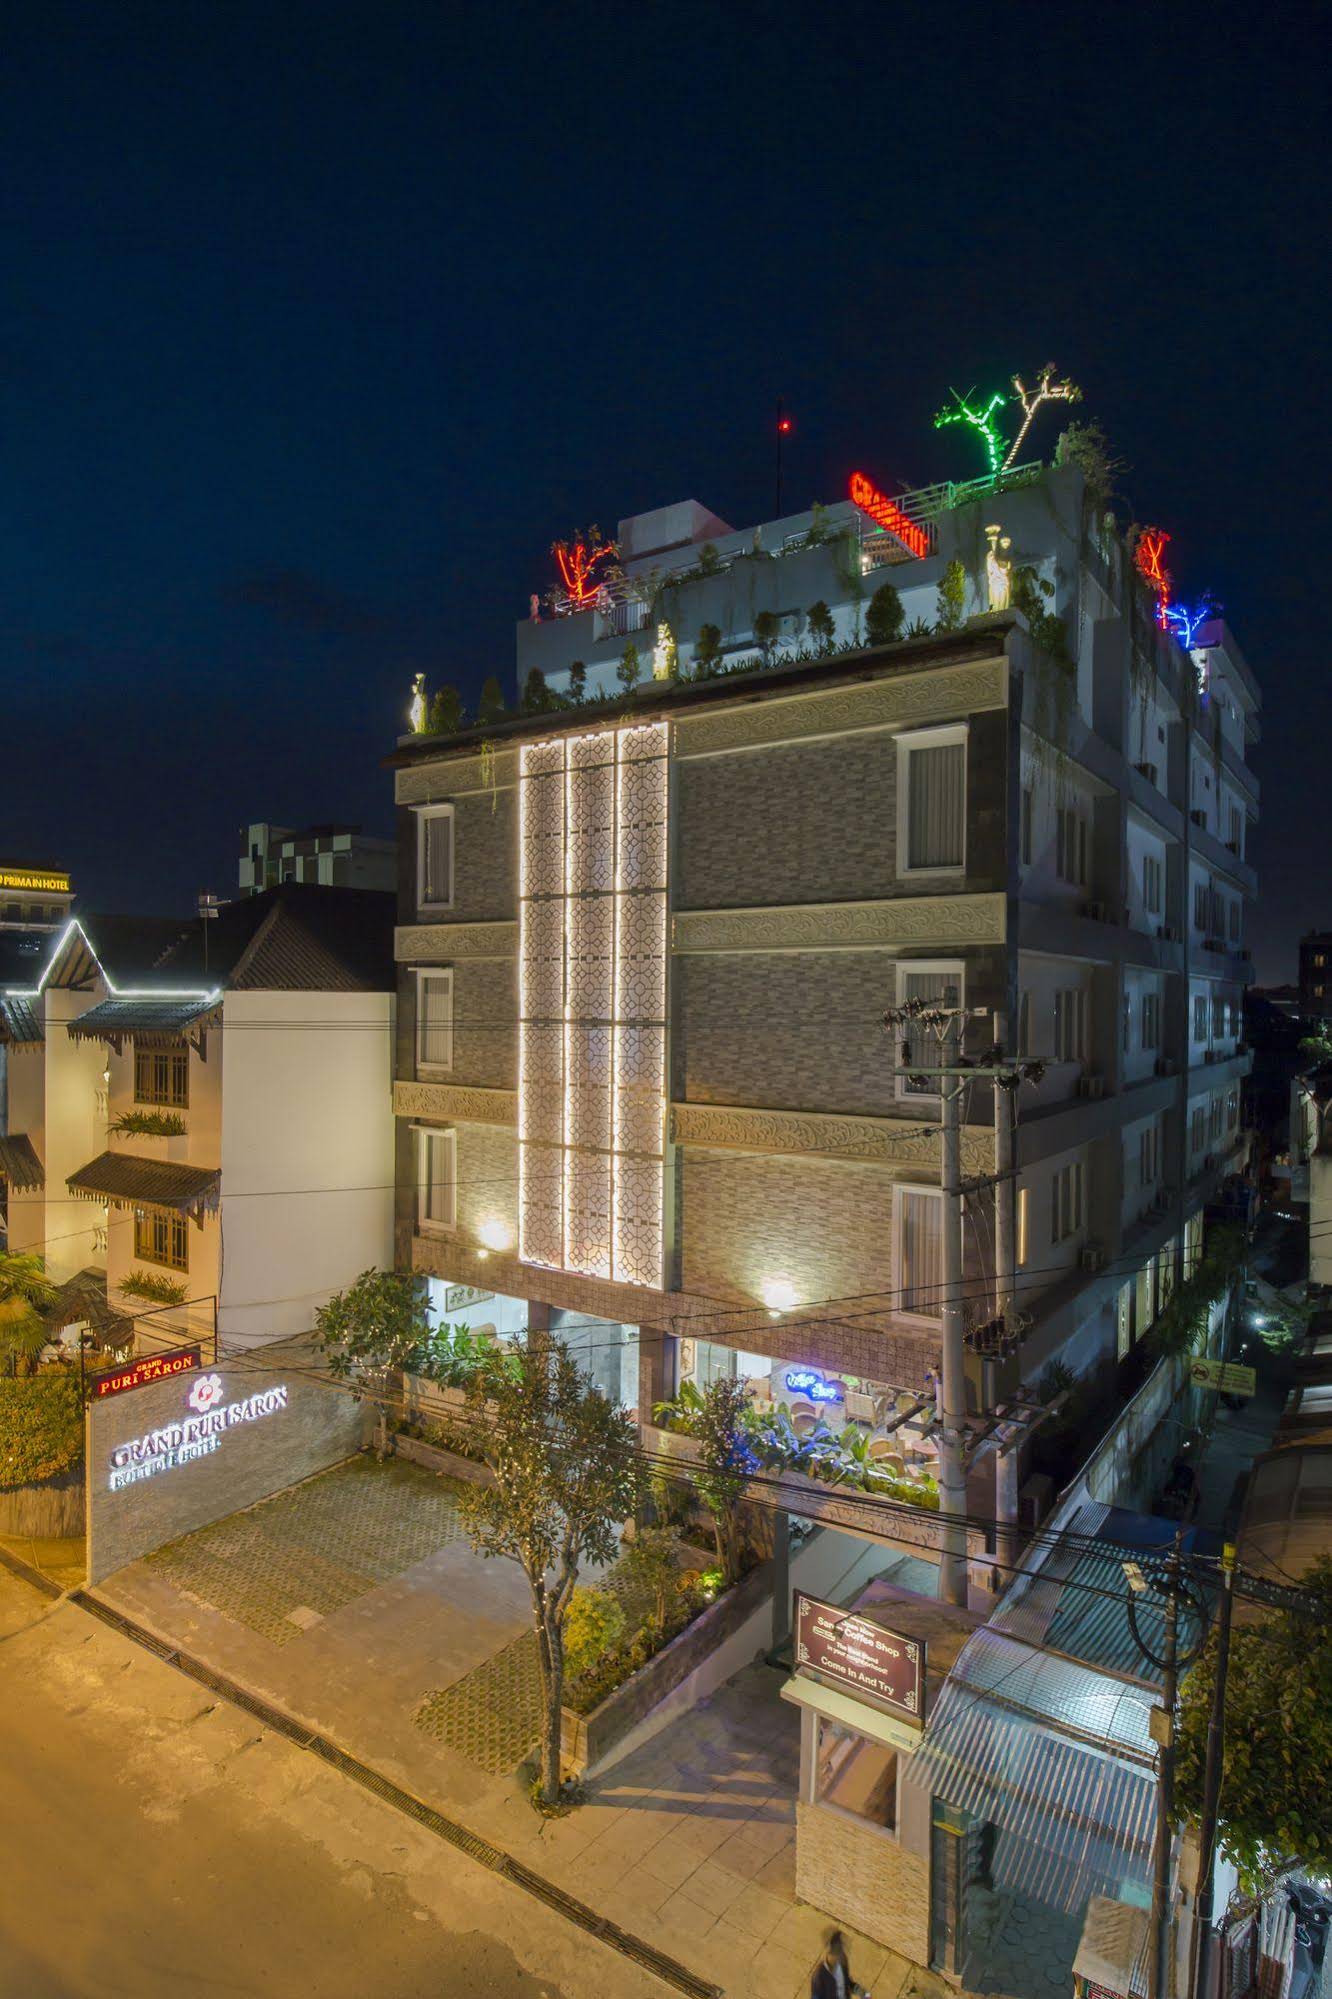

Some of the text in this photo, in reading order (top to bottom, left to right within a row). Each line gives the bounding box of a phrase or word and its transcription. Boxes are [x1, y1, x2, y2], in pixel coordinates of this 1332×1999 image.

[4, 875, 69, 891] PRIMA IN HOTEL
[100, 1356, 193, 1394] PURI SARON
[136, 1359, 162, 1372] GRAND
[110, 1387, 289, 1468] GRAND PURI SARON
[182, 1436, 221, 1462] HOTEL
[844, 1628, 874, 1646] Coffee
[875, 1641, 900, 1658] Shop
[820, 1656, 895, 1696] Come In And Try
